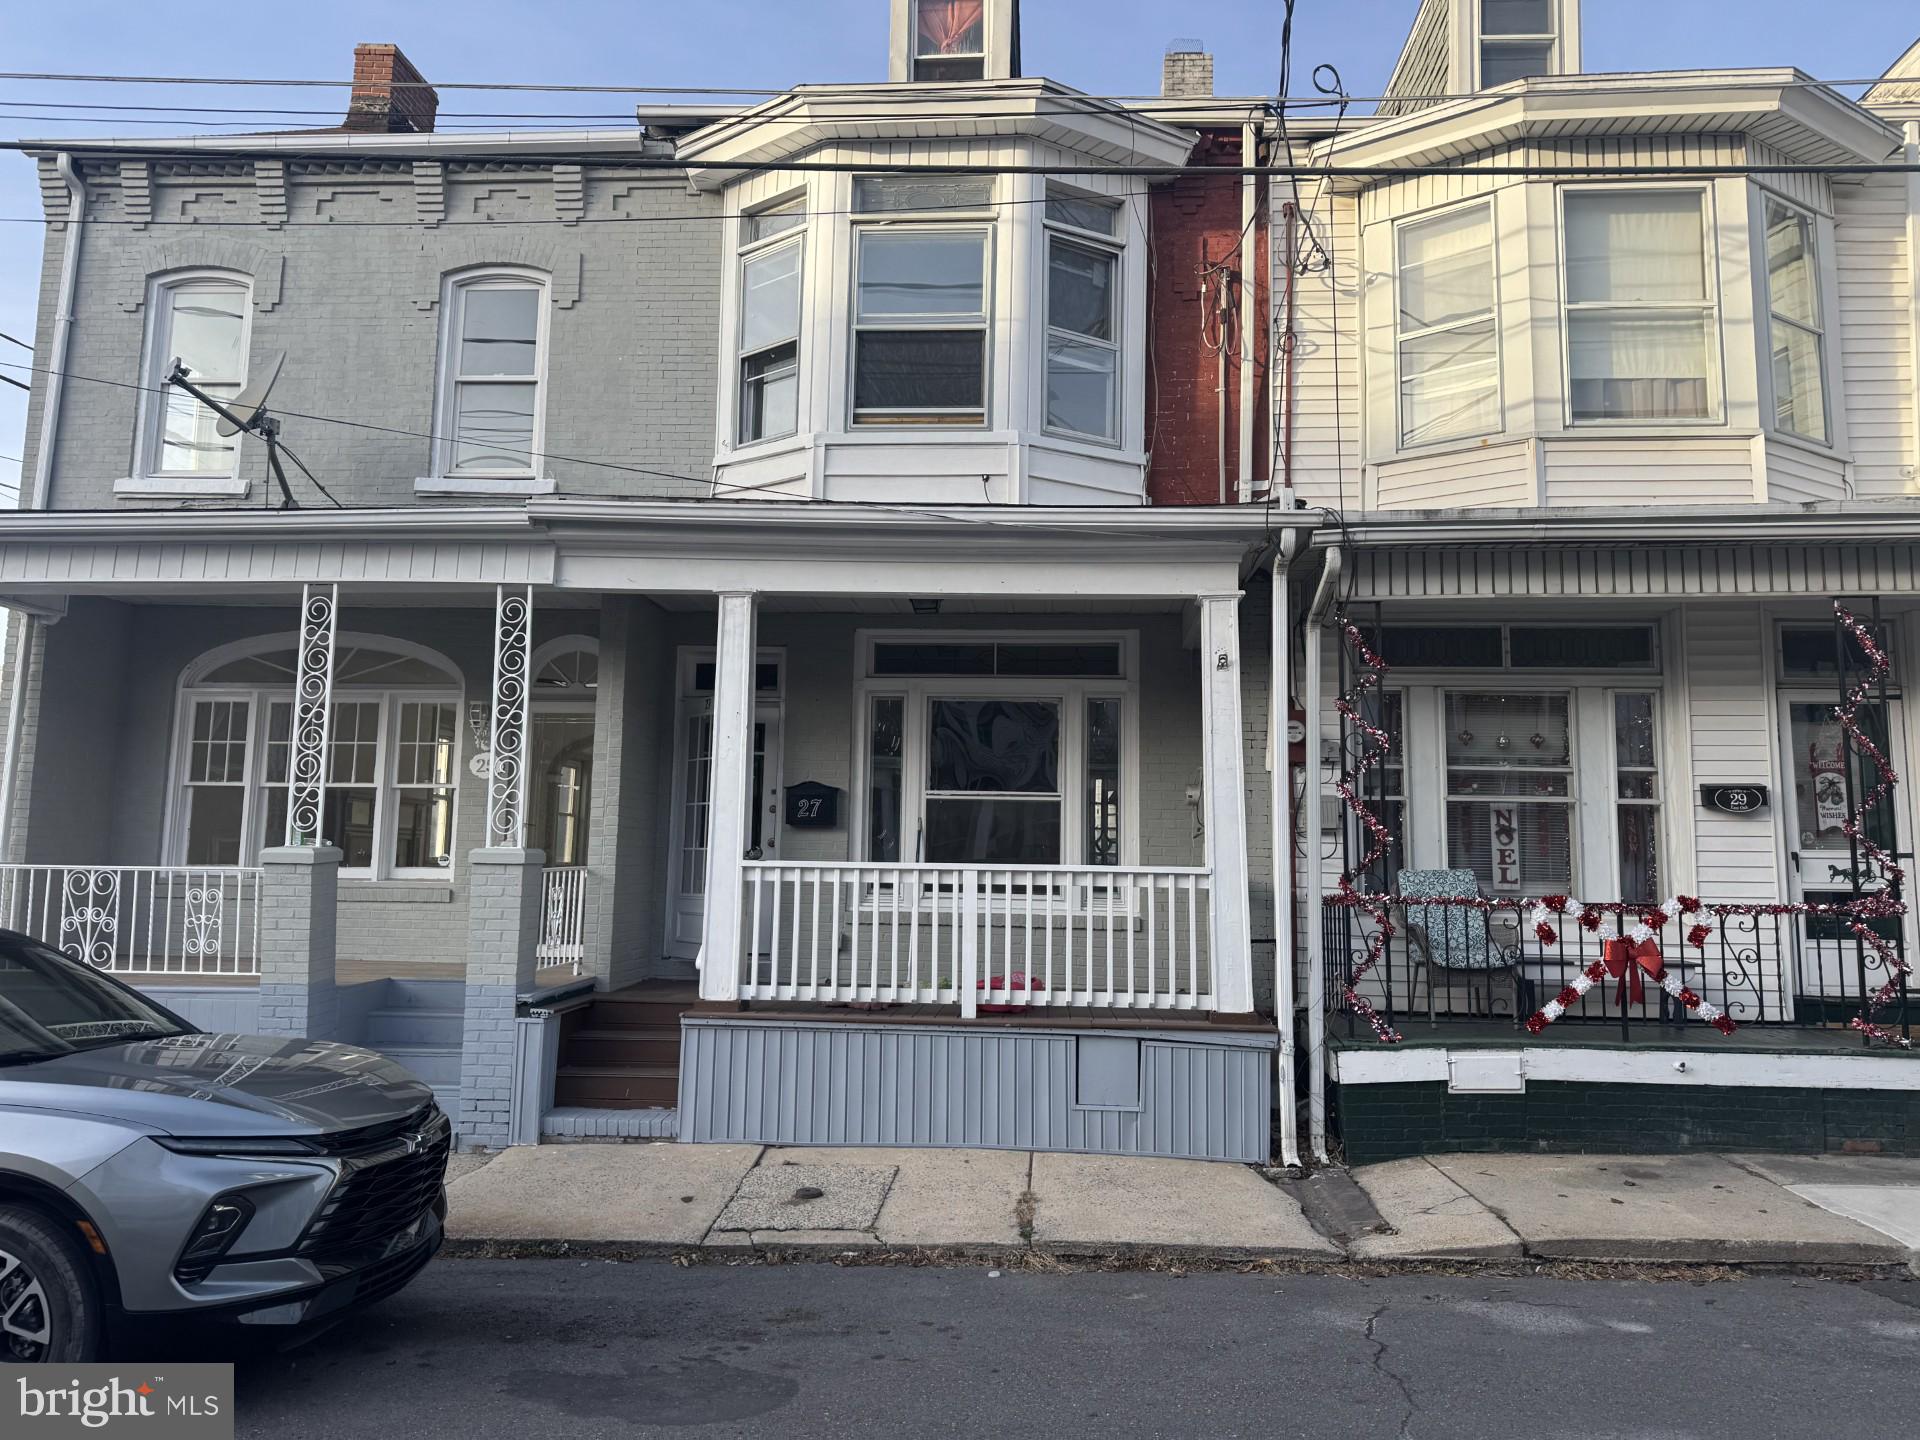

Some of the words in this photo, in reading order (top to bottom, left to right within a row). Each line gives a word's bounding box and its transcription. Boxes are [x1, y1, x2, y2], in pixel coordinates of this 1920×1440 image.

[1813, 759, 1846, 769] WELCOME
[1730, 793, 1747, 805] 29
[797, 798, 823, 818] 27
[1494, 808, 1519, 885] NOEL
